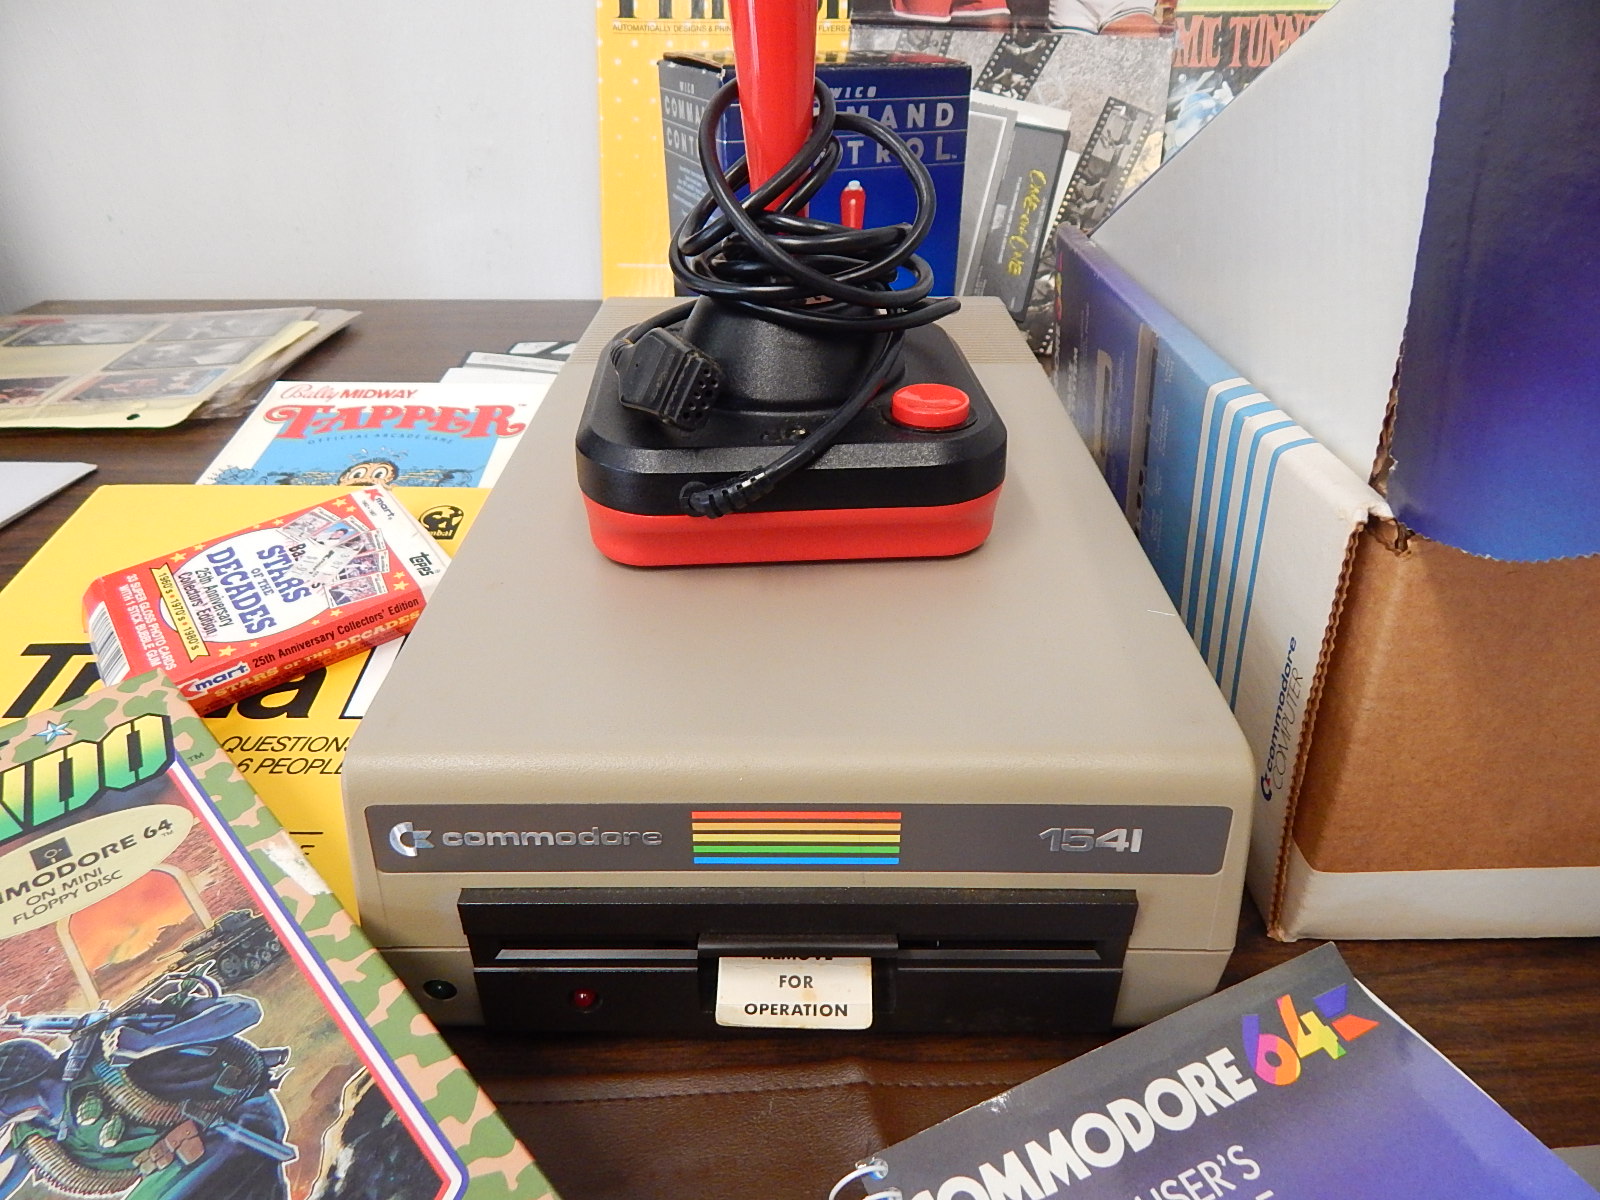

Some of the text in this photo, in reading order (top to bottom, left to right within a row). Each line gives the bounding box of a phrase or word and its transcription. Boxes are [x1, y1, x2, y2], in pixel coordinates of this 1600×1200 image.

[612, 24, 671, 33] AUTOMATICALLY
[674, 24, 707, 33] DESIGNS
[828, 86, 877, 98] WICO
[280, 384, 418, 402] Bally MIDWAY
[263, 404, 526, 440] TAPPER
[256, 545, 312, 603] STARS
[257, 578, 274, 596] THE
[131, 581, 148, 603] SUPER
[195, 567, 235, 628] 25th Anniversary
[206, 546, 278, 634] DECADES
[138, 601, 157, 624] GLOSS
[196, 606, 218, 636] Edition
[148, 621, 166, 646] PHOTO
[252, 653, 276, 668] 25th
[278, 631, 335, 659] Anniversary
[337, 609, 385, 635] Collectors'
[388, 598, 420, 616] Edition
[334, 610, 420, 650] DECADES
[145, 647, 161, 668] GUM
[157, 643, 177, 671] CARDS
[1266, 636, 1297, 771] commodore
[1272, 666, 1304, 790] COMPUTER
[221, 735, 348, 754] QUESTION
[442, 827, 662, 847] commodore
[1039, 827, 1143, 853] 1541
[0, 834, 138, 905] MODORE
[143, 818, 173, 840] 64
[12, 869, 123, 926] FLOPPY DISC
[26, 866, 103, 906] ON MINI
[779, 975, 814, 989] FOR
[744, 1003, 848, 1017] OPERATION
[905, 994, 1346, 1200] MMODORE 64
